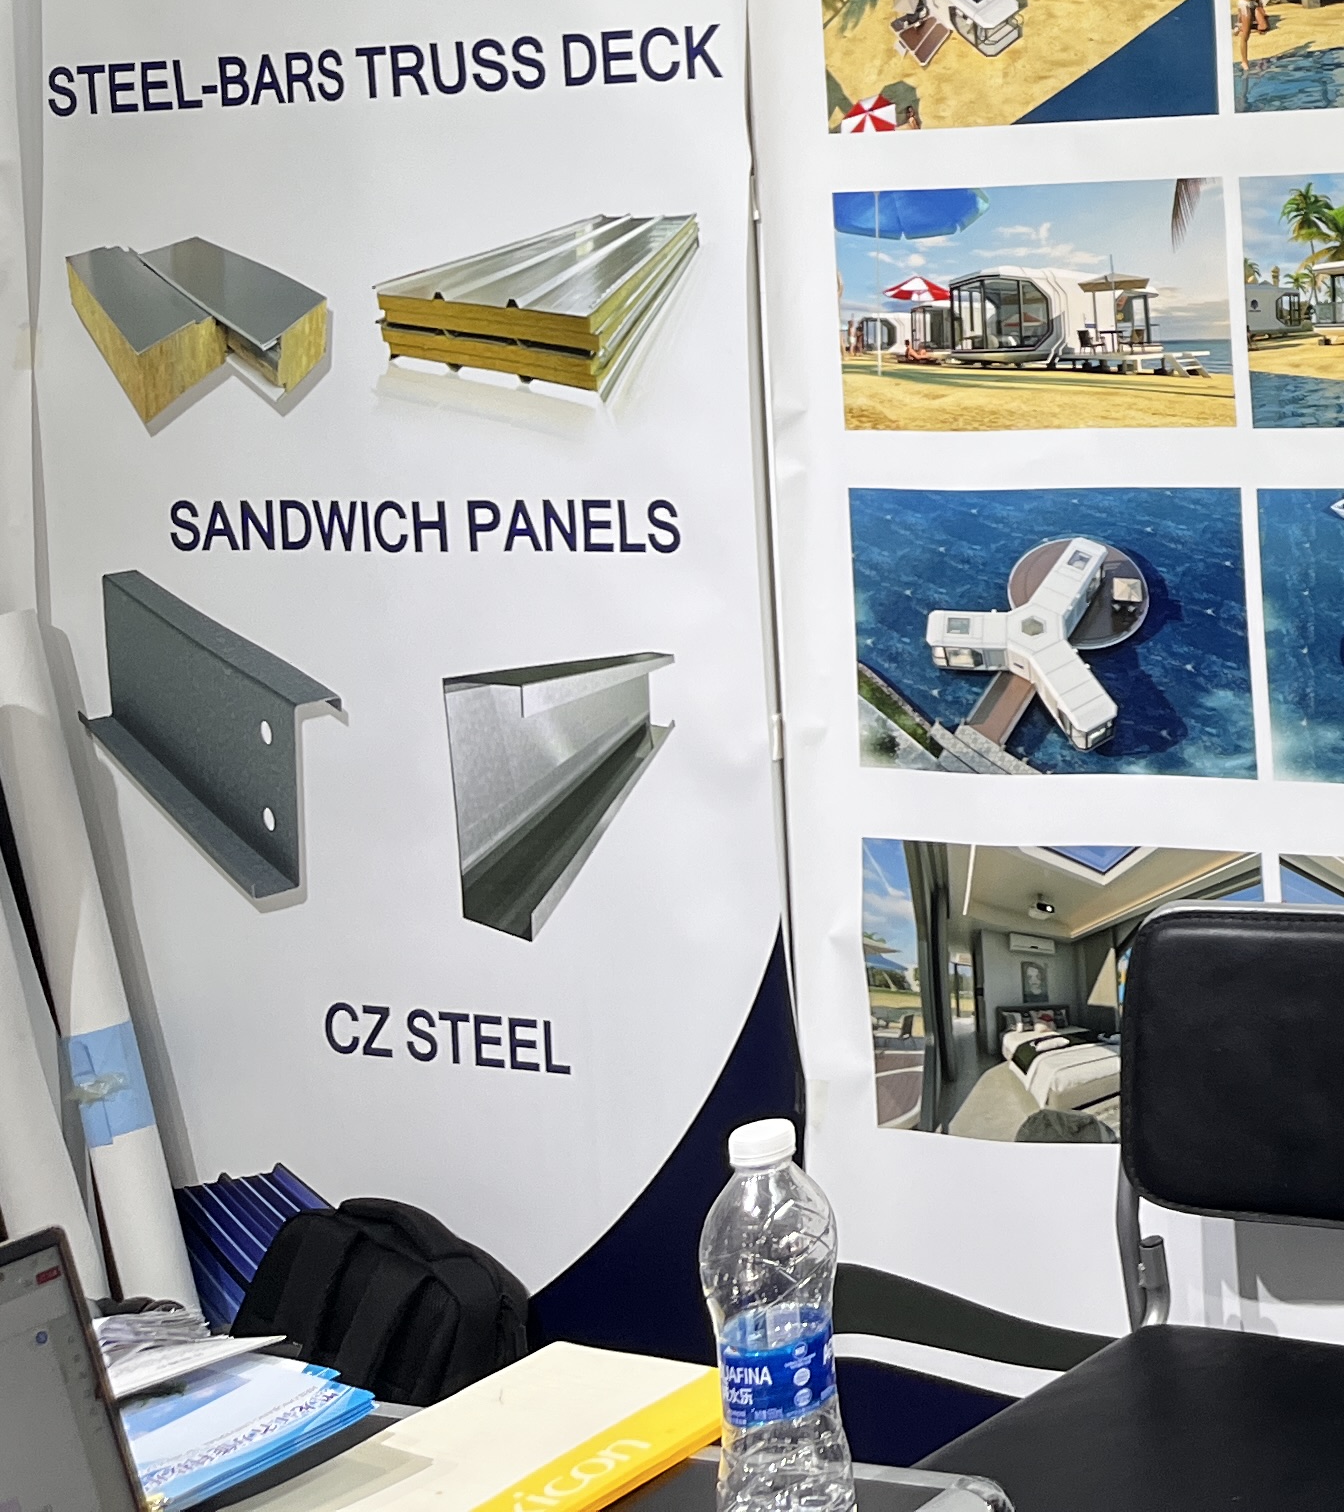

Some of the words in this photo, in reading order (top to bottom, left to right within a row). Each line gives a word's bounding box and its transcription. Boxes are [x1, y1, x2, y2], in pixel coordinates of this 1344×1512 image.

[48, 49, 345, 117] STEEL-BARS
[355, 35, 546, 99] TRUSS
[561, 23, 723, 87] DECK
[170, 499, 449, 553] SANDWICH
[467, 499, 682, 554] PANELS
[325, 1002, 393, 1058] CZ
[407, 1008, 571, 1075] STEEL
